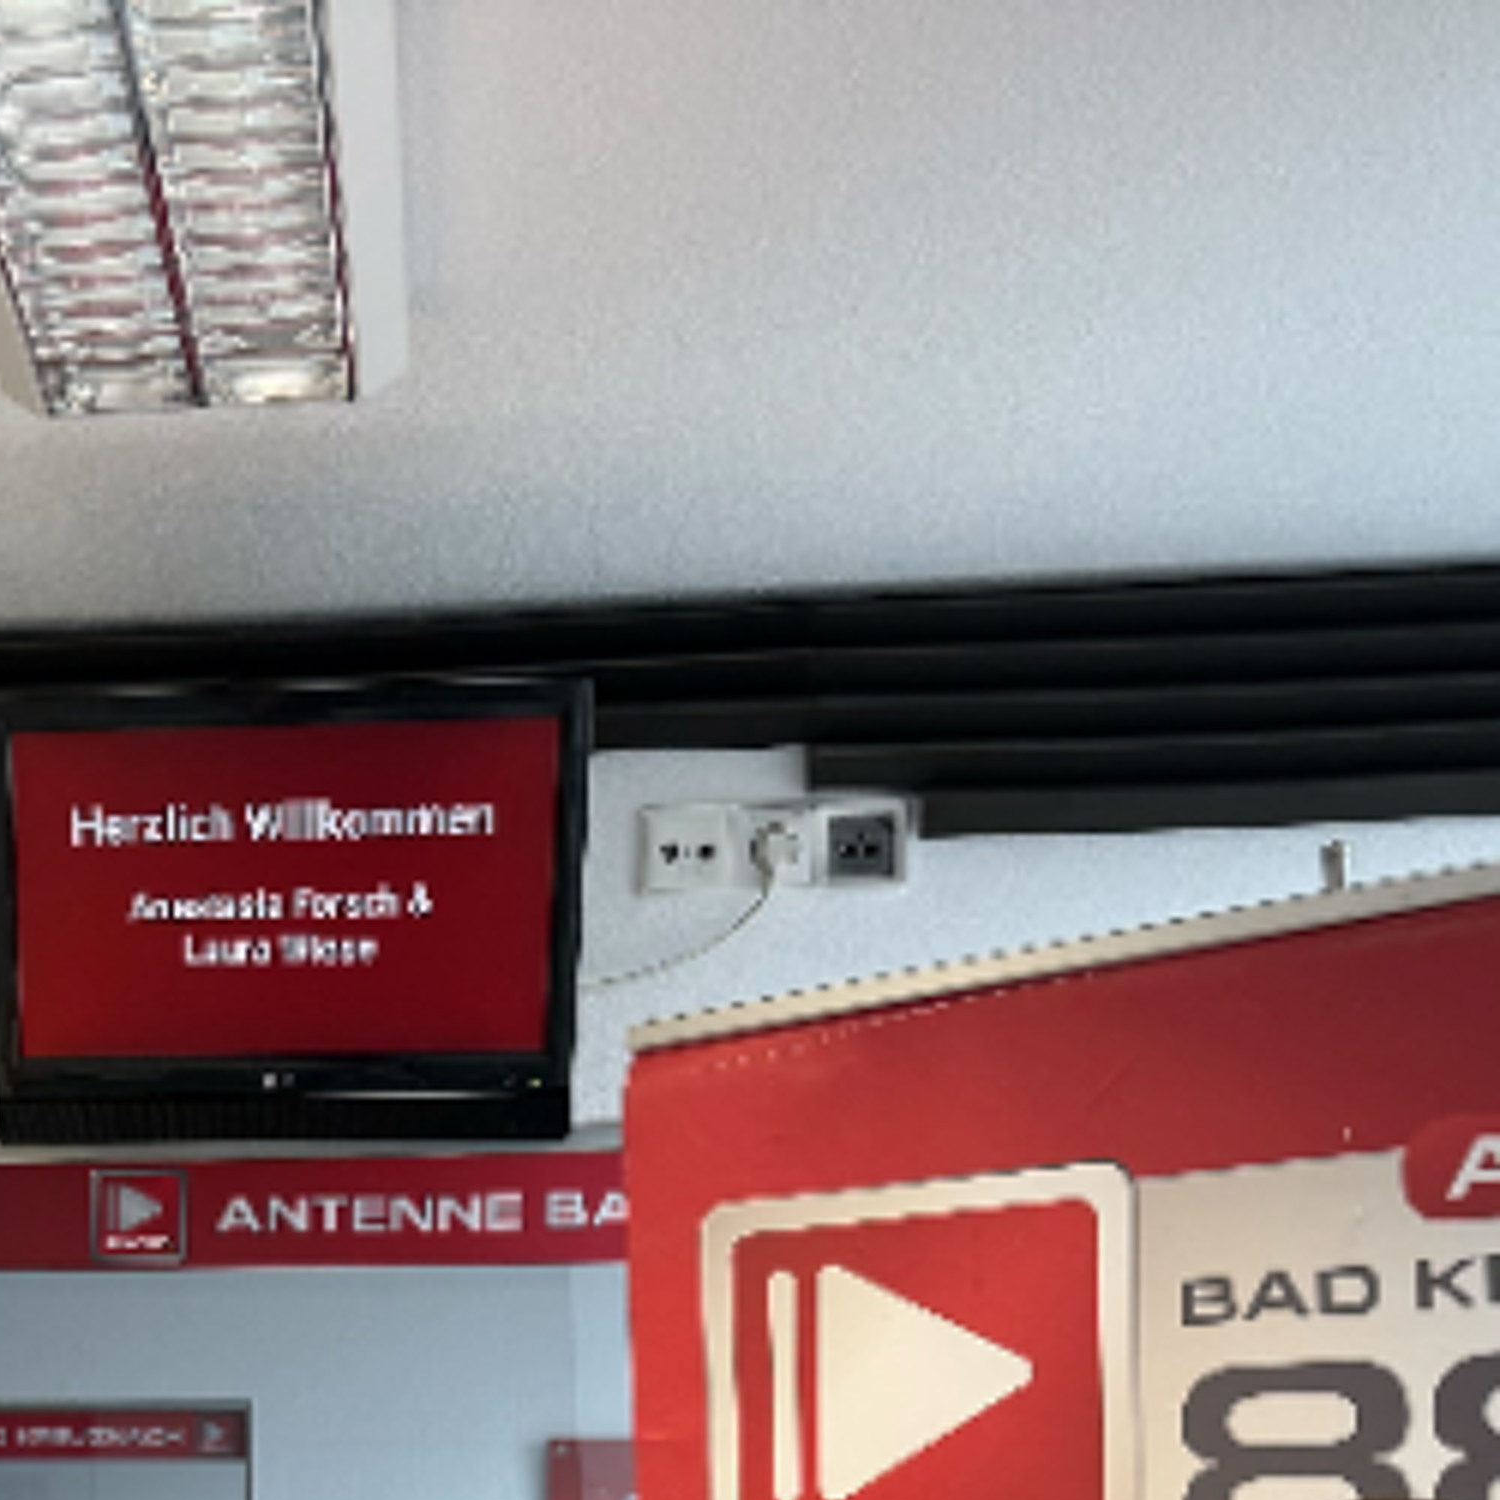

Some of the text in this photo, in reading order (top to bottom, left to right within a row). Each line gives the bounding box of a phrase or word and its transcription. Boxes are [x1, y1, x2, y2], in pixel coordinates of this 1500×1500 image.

[69, 800, 496, 848] Herzlich Willkommen
[184, 935, 272, 967] Laura
[215, 1193, 525, 1233] ANTENNE
[1182, 1252, 1500, 1328] BAD K
